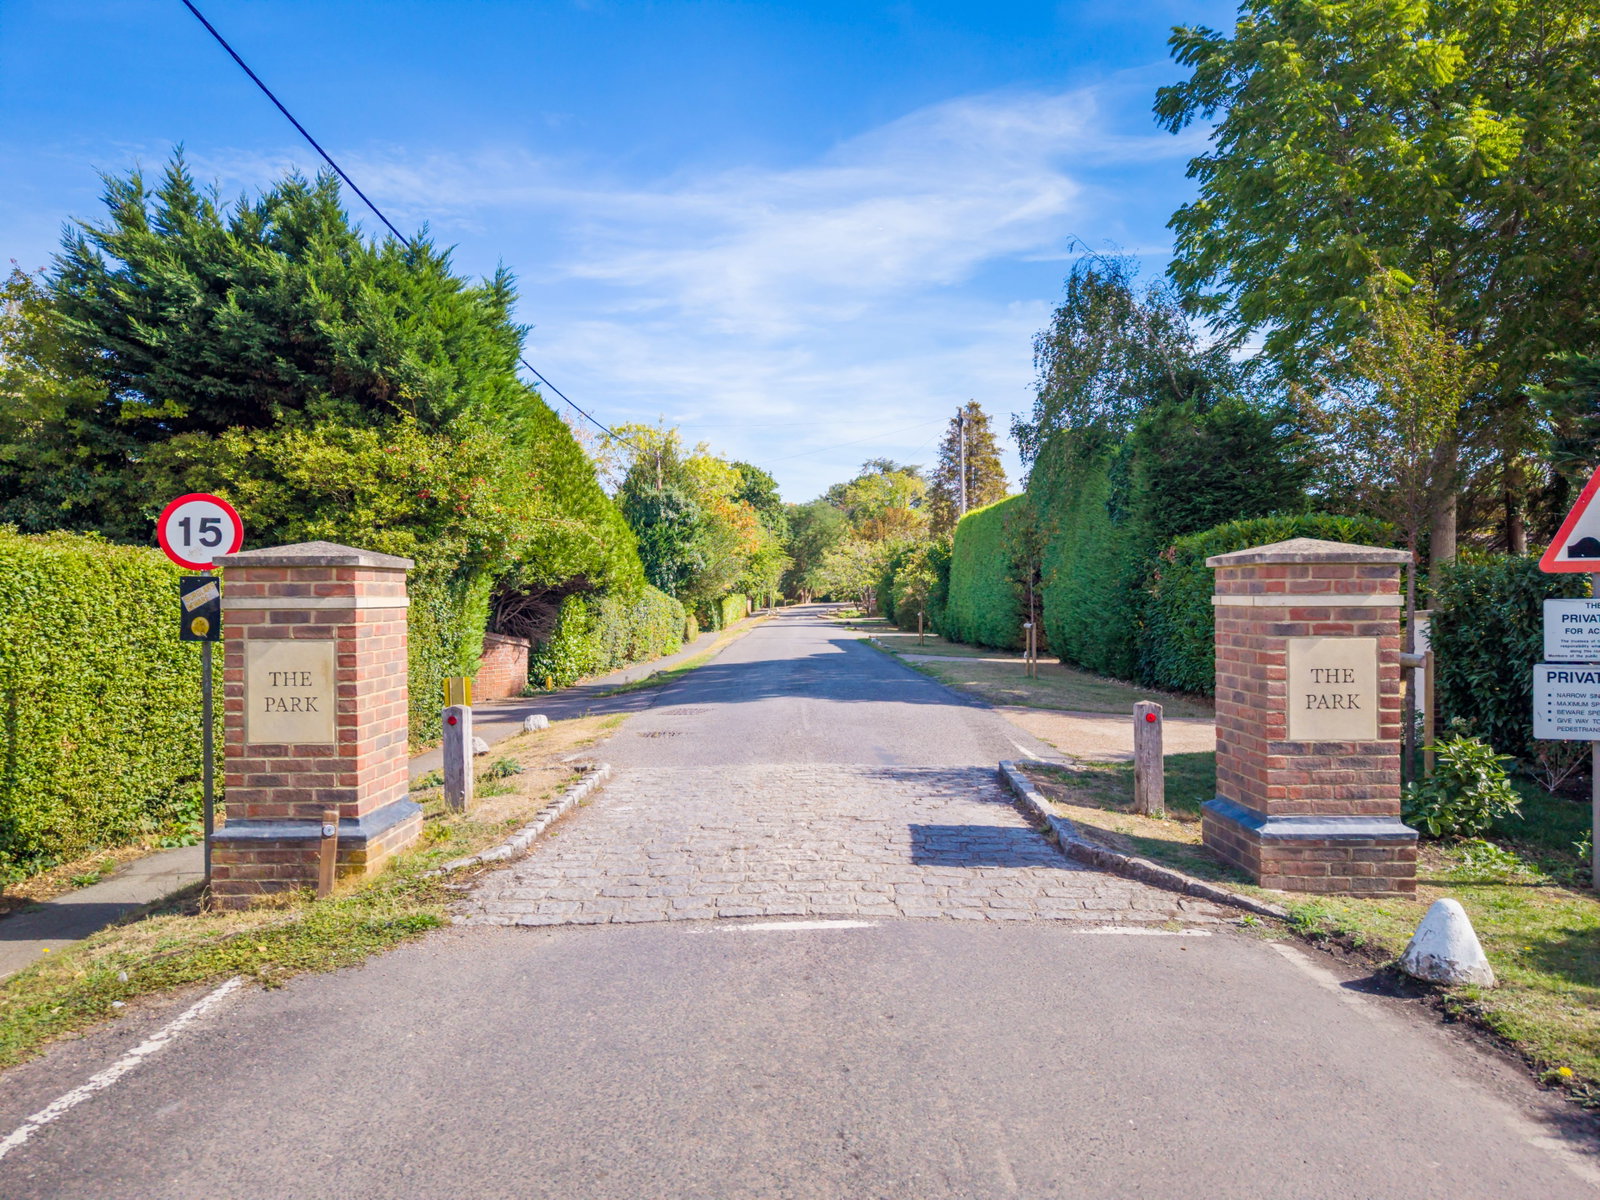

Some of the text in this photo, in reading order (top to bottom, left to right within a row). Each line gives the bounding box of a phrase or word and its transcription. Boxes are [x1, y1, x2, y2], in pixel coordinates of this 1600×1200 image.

[178, 516, 223, 548] 15
[268, 671, 313, 687] THE
[1310, 668, 1355, 684] THE
[1547, 671, 1600, 683] PRIVAT
[264, 696, 319, 713] PARK
[1305, 693, 1361, 710] PARK
